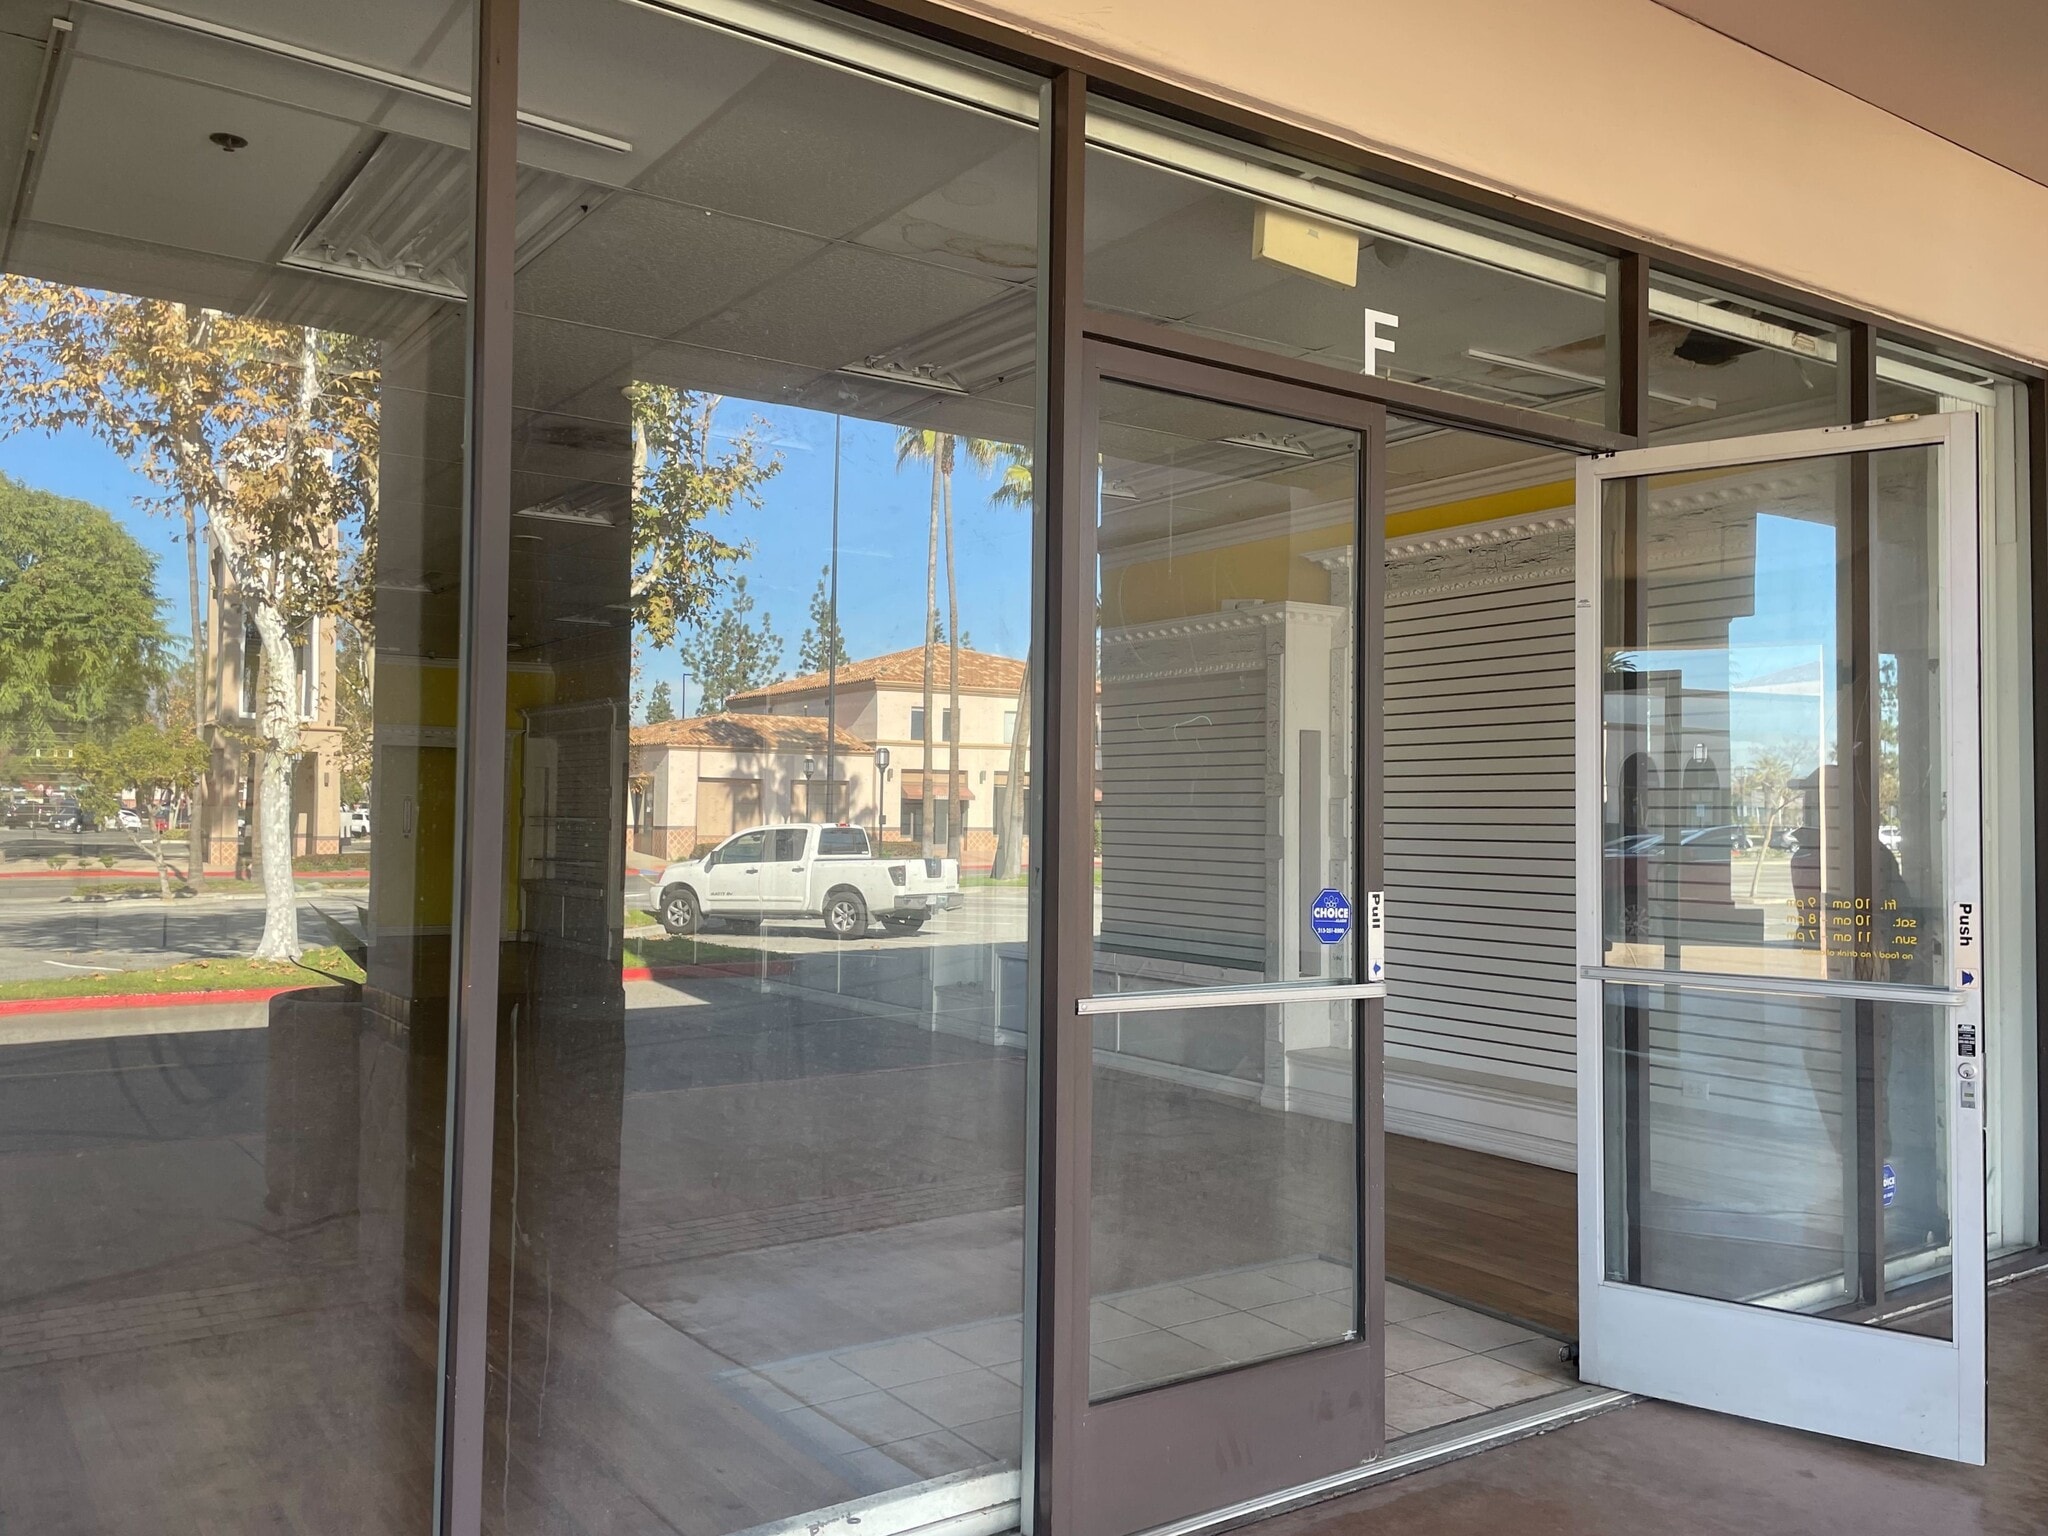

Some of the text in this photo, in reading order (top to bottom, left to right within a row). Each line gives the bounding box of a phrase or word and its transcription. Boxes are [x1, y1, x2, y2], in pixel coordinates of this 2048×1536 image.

[1365, 308, 1398, 376] F
[1314, 907, 1349, 919] CHOICE
[1372, 893, 1381, 928] Pull
[1959, 903, 1973, 947] Push
